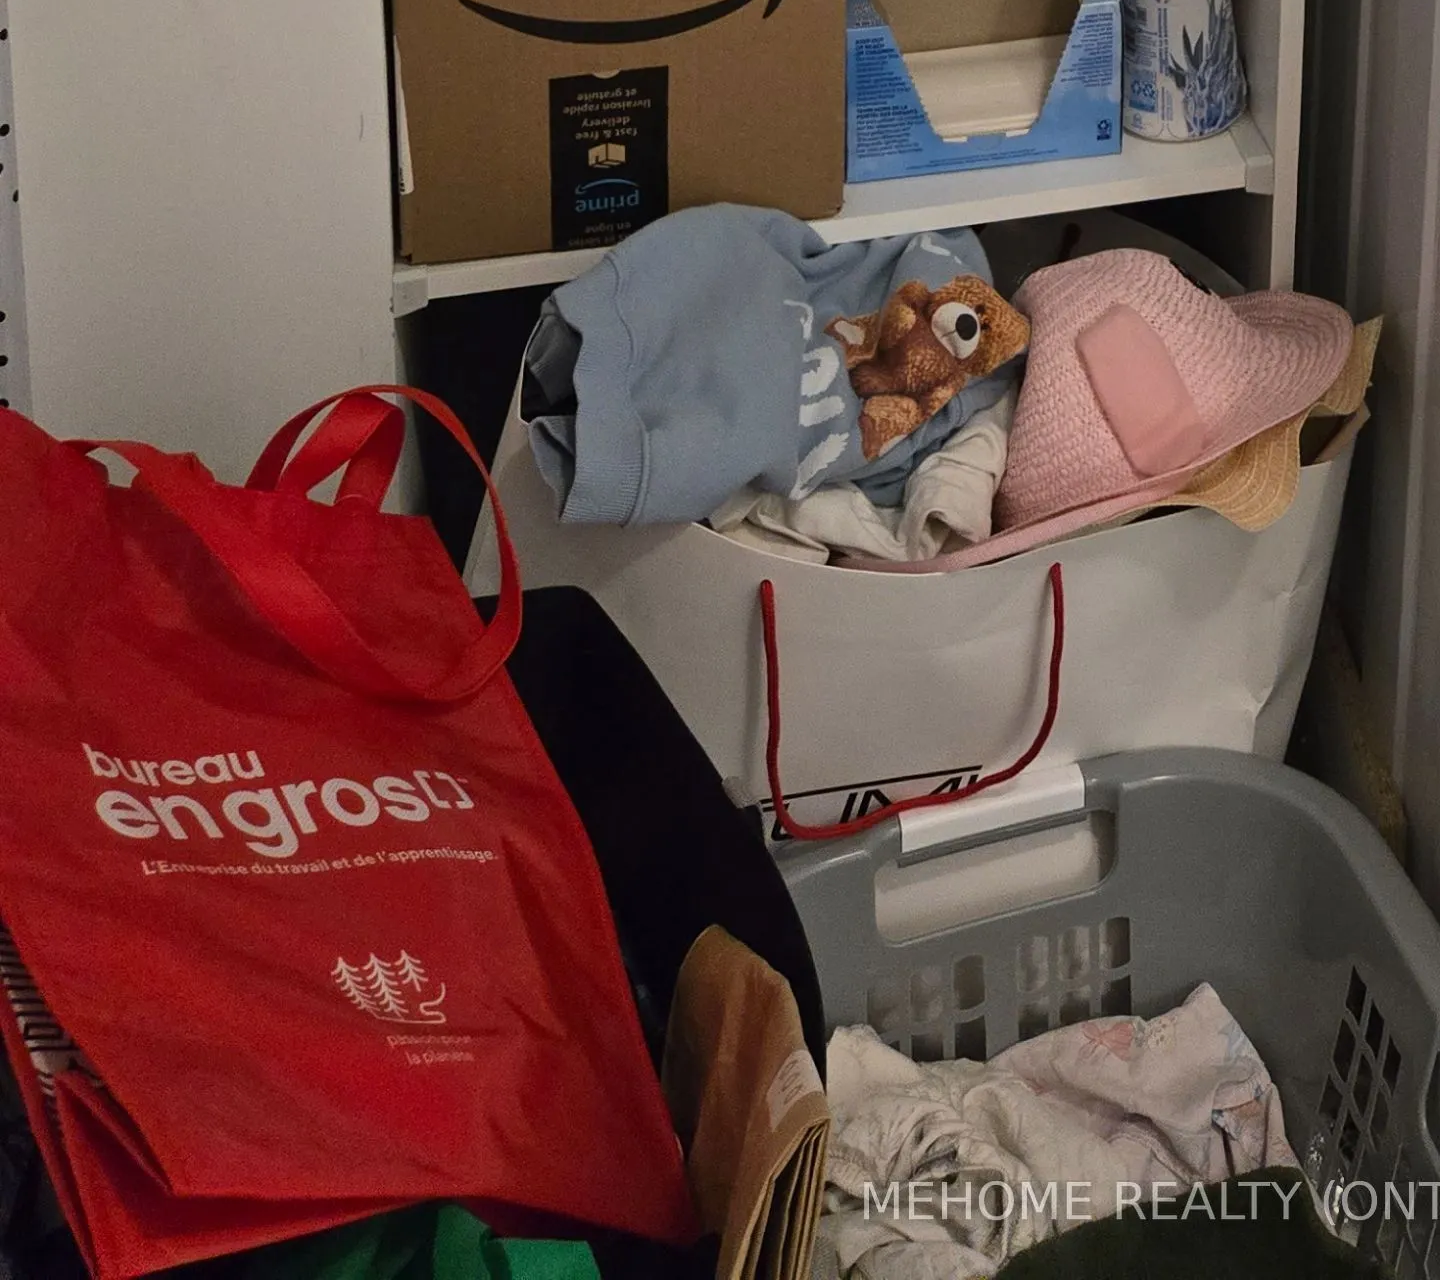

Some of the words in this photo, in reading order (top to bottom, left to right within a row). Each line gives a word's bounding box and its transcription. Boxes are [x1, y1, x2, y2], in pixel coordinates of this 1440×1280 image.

[577, 88, 623, 101] gratuite
[563, 103, 600, 116] rapide
[603, 99, 651, 111] livraison
[581, 116, 631, 128] delivery
[575, 131, 600, 140] free
[615, 127, 638, 137] fast
[574, 189, 640, 213] prime
[82, 742, 266, 788] bureau
[251, 862, 276, 875] du
[277, 858, 330, 875] travail
[332, 856, 351, 870] et
[353, 853, 376, 867] de
